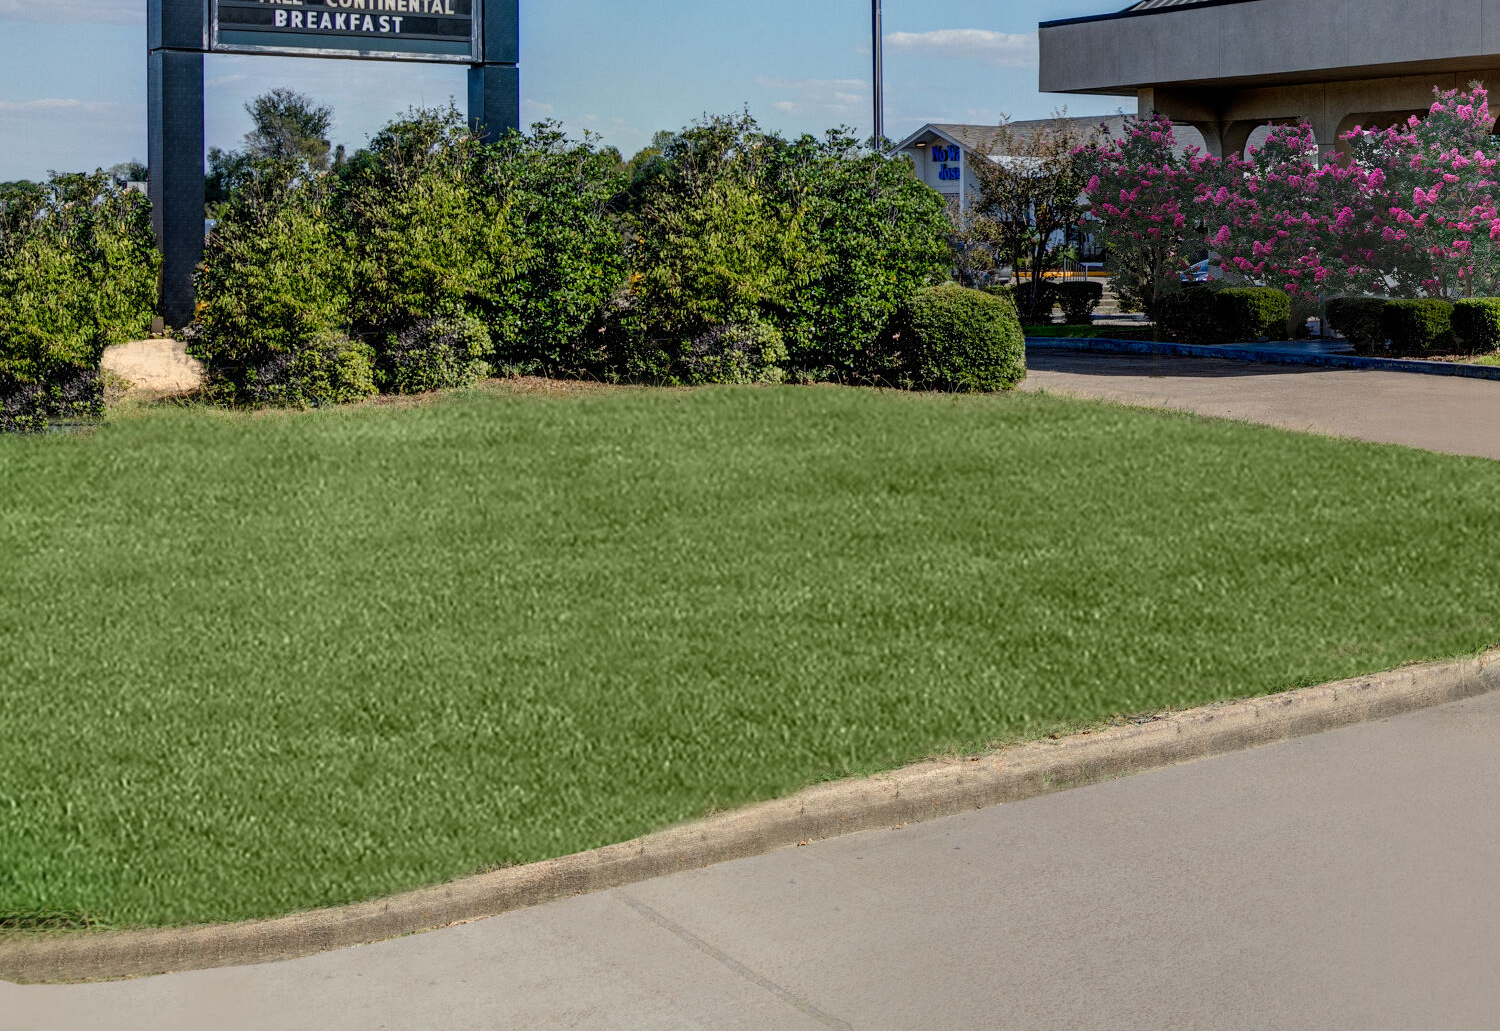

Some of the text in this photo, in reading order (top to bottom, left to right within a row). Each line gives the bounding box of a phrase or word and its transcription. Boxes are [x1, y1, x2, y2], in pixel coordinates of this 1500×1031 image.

[274, 9, 403, 33] BREAKFAST
[932, 145, 960, 161] No Wa
